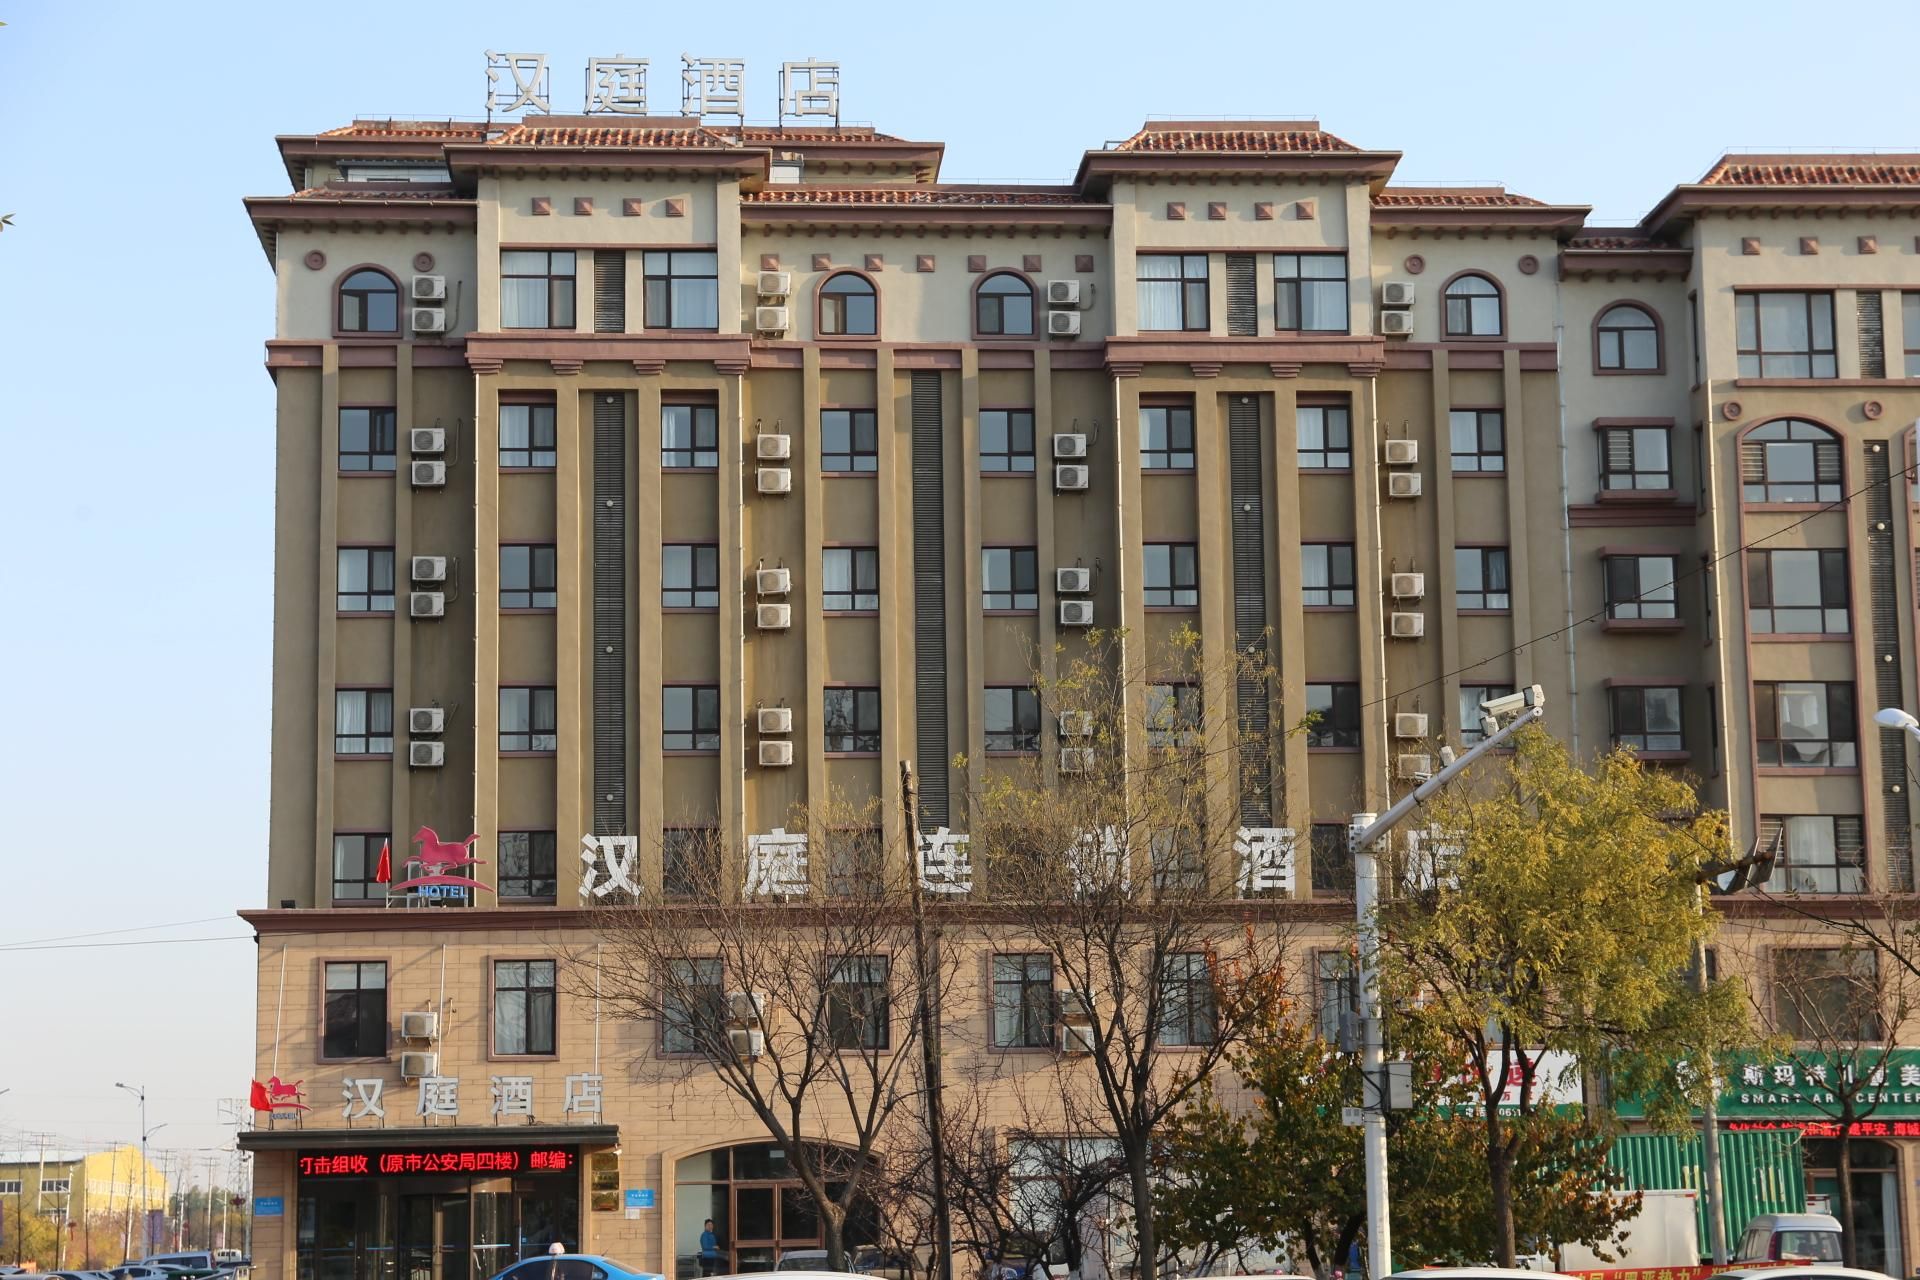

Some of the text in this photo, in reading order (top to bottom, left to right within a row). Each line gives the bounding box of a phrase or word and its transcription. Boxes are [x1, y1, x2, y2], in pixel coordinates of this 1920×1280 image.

[484, 49, 840, 117] 汉庭酒店
[418, 885, 468, 898] HOTEL
[341, 1072, 603, 1120] 汉庭酒店
